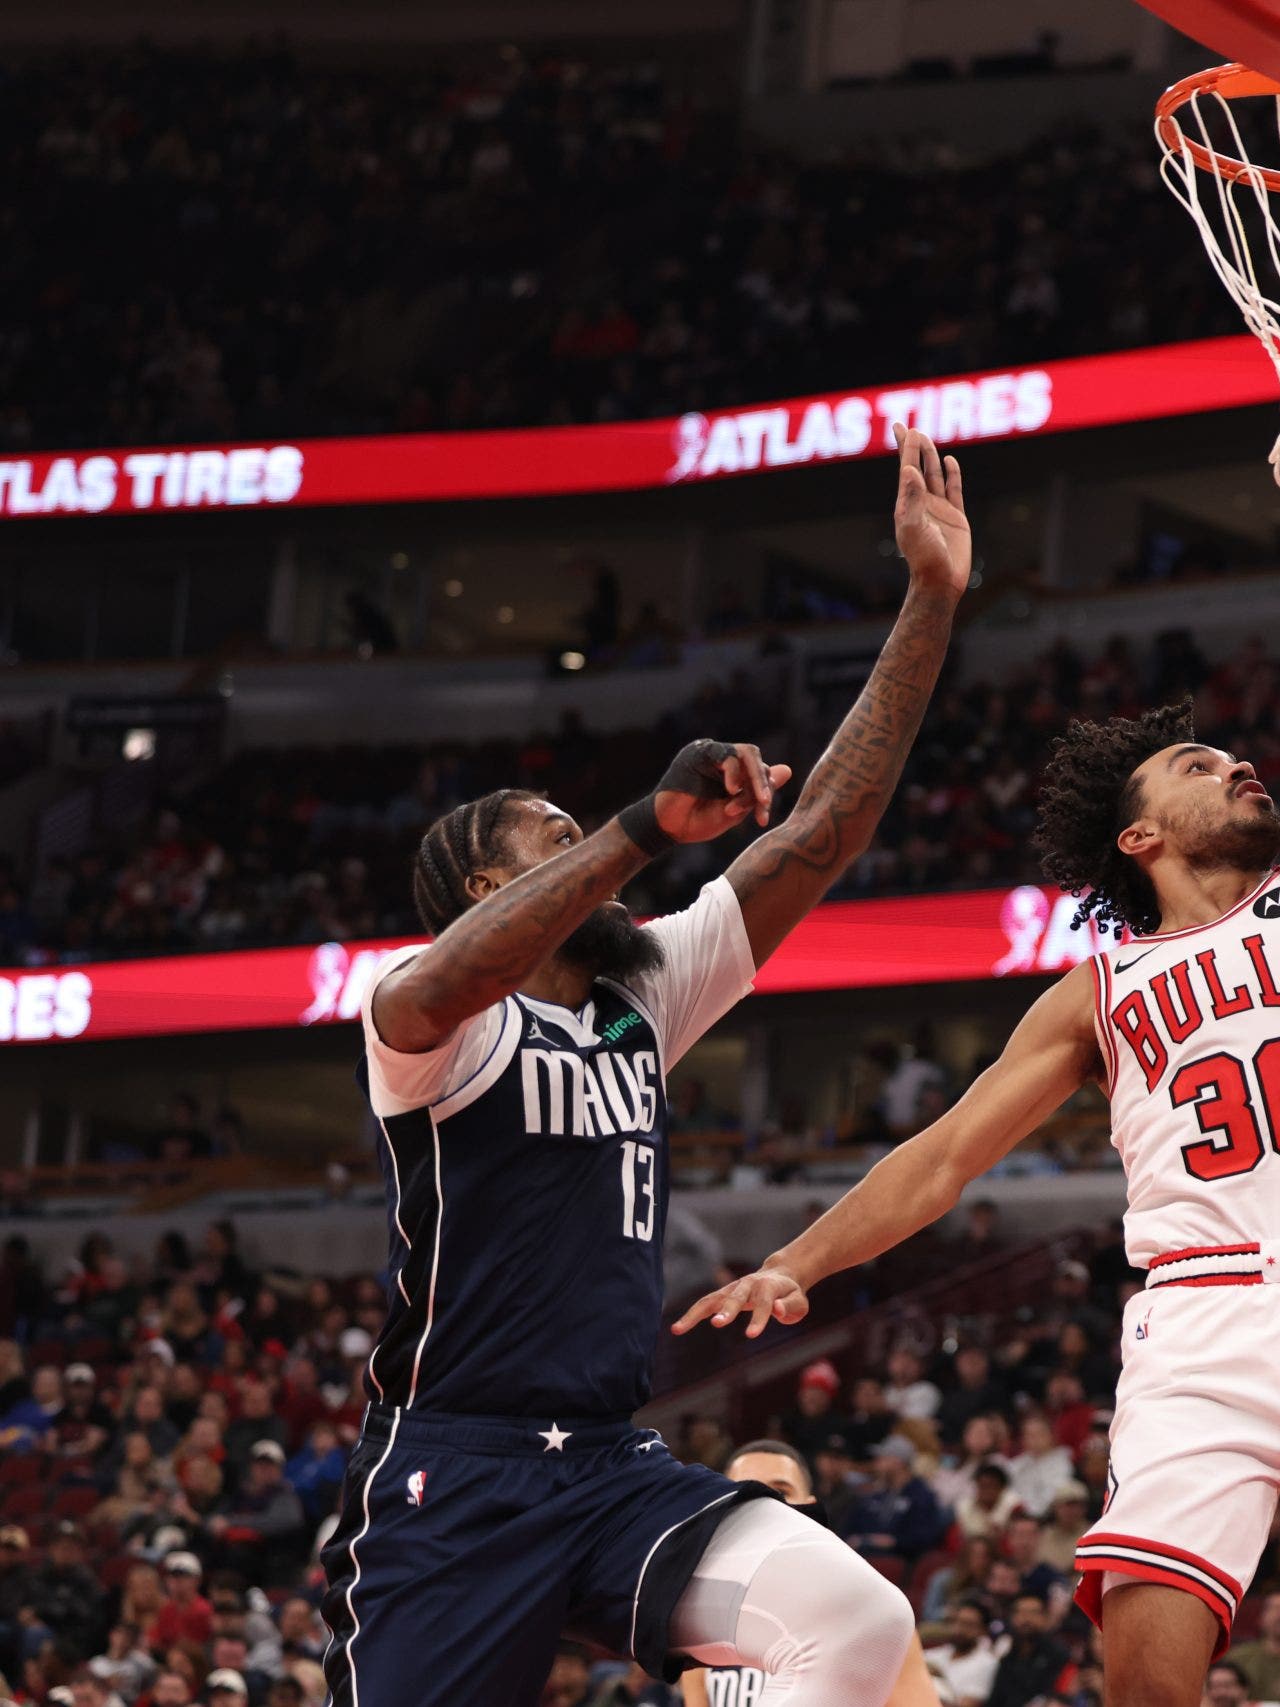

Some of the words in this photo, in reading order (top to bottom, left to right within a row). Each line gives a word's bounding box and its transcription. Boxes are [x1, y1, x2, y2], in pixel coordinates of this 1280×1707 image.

[701, 396, 873, 475] ATLAS
[876, 370, 1053, 450] TIRES
[123, 446, 303, 508] TIRES
[620, 1140, 655, 1242] 13
